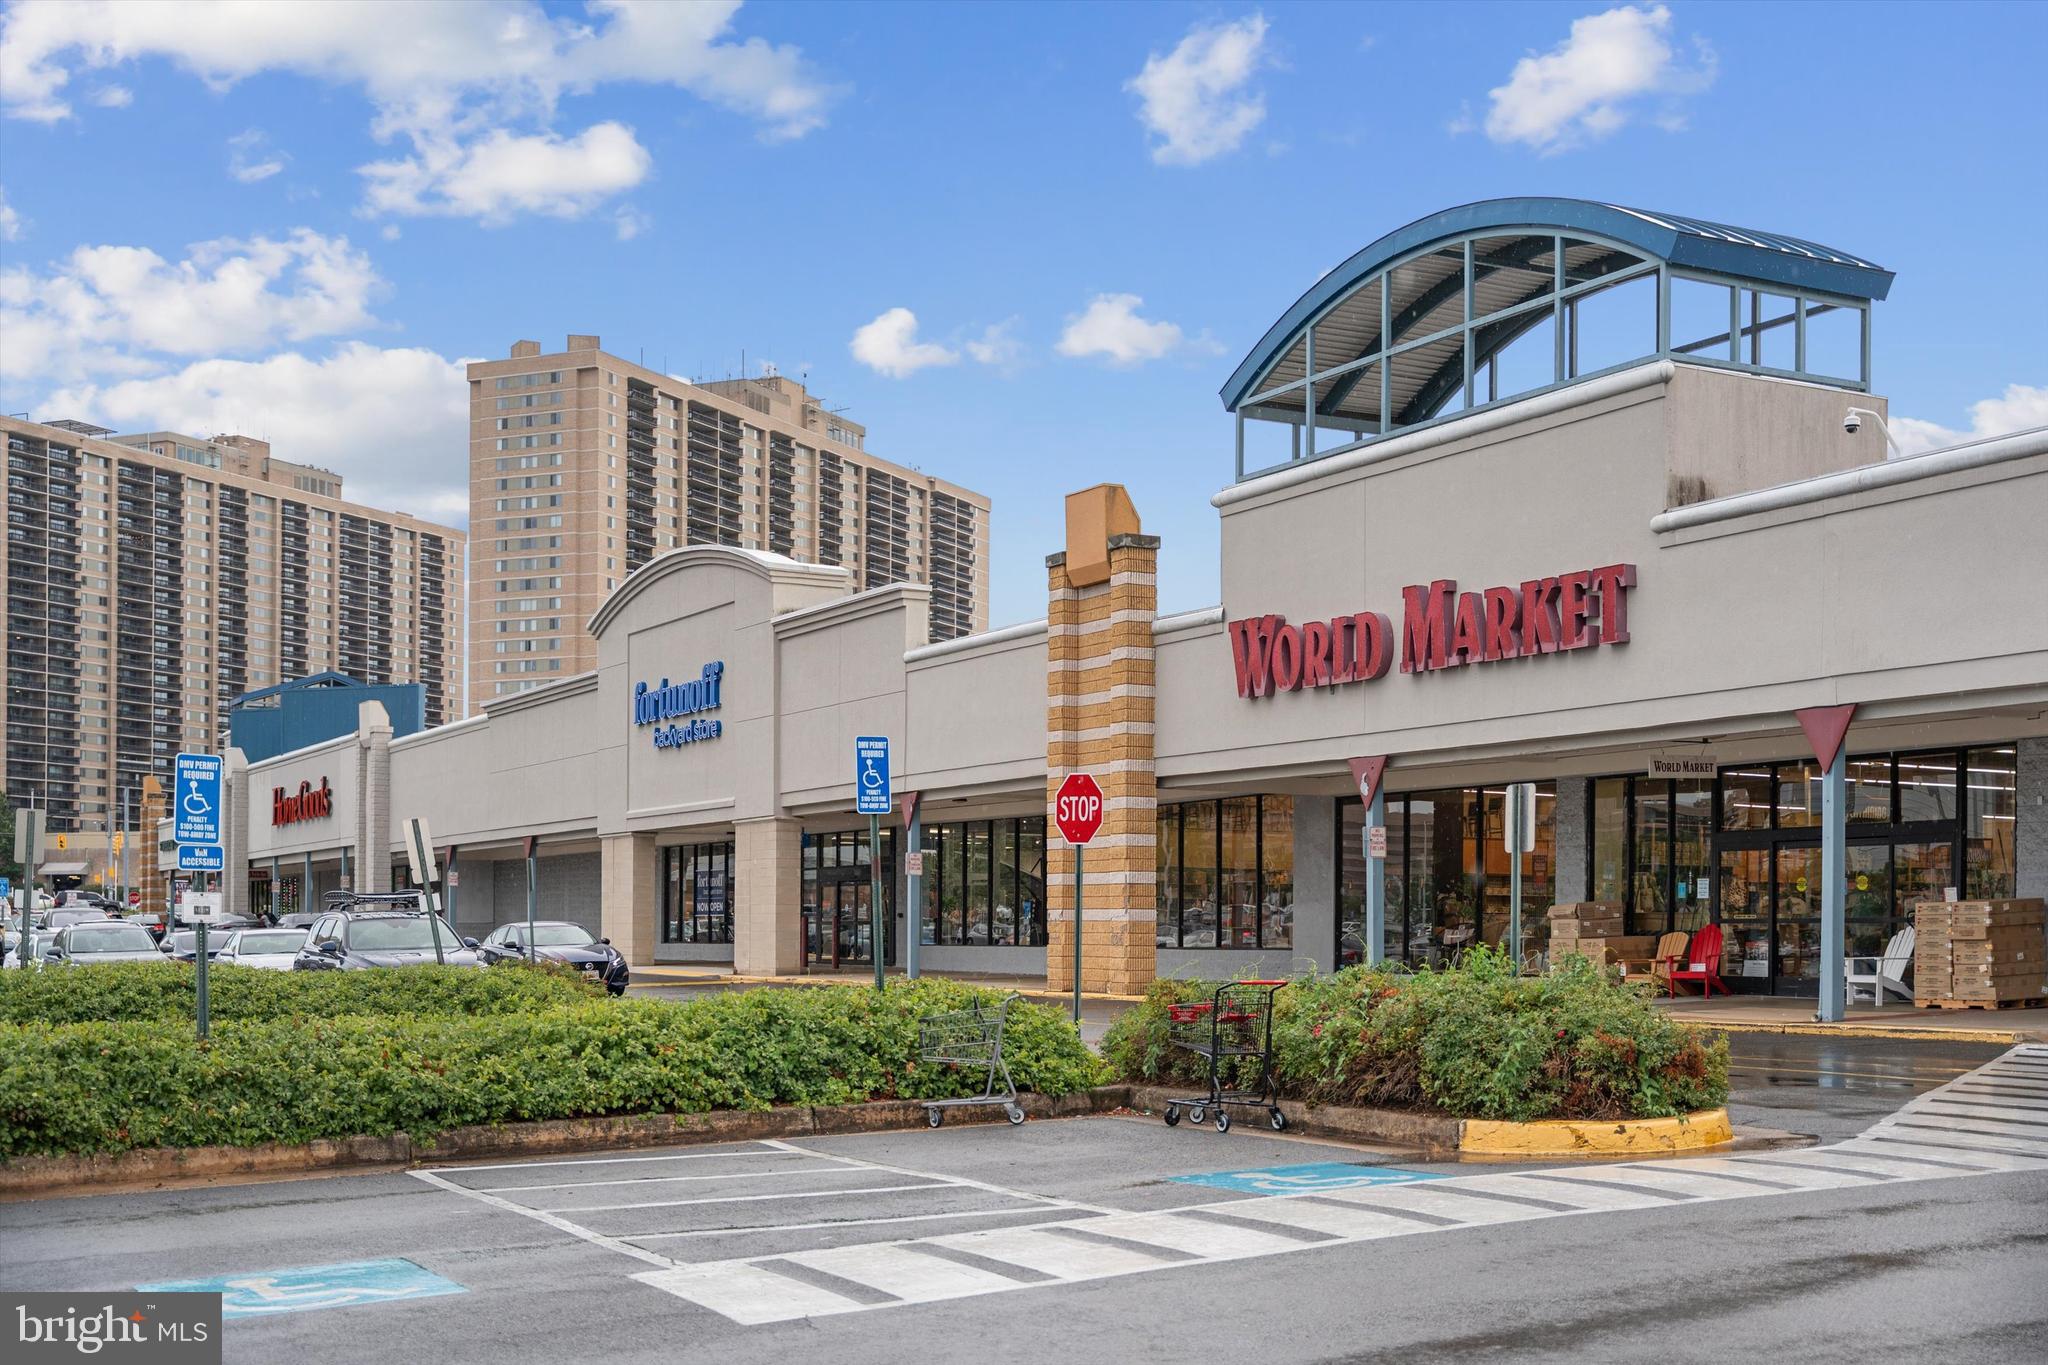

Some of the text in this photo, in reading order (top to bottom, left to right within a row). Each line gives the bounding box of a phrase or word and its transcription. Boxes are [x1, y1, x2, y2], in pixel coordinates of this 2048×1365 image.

[1229, 563, 1637, 698] WORLD MARKET
[634, 660, 724, 726] fortunoff
[654, 719, 722, 748] backyard store
[180, 760, 219, 770] DMV PERMIT
[1654, 760, 1714, 772] WORLD MARKET
[183, 770, 214, 780] REQUIRED
[272, 776, 332, 826] HomeGoods
[1060, 796, 1099, 822] STOP
[182, 857, 220, 866] ACCESSIBLE
[696, 902, 723, 912] NOW OPEN
